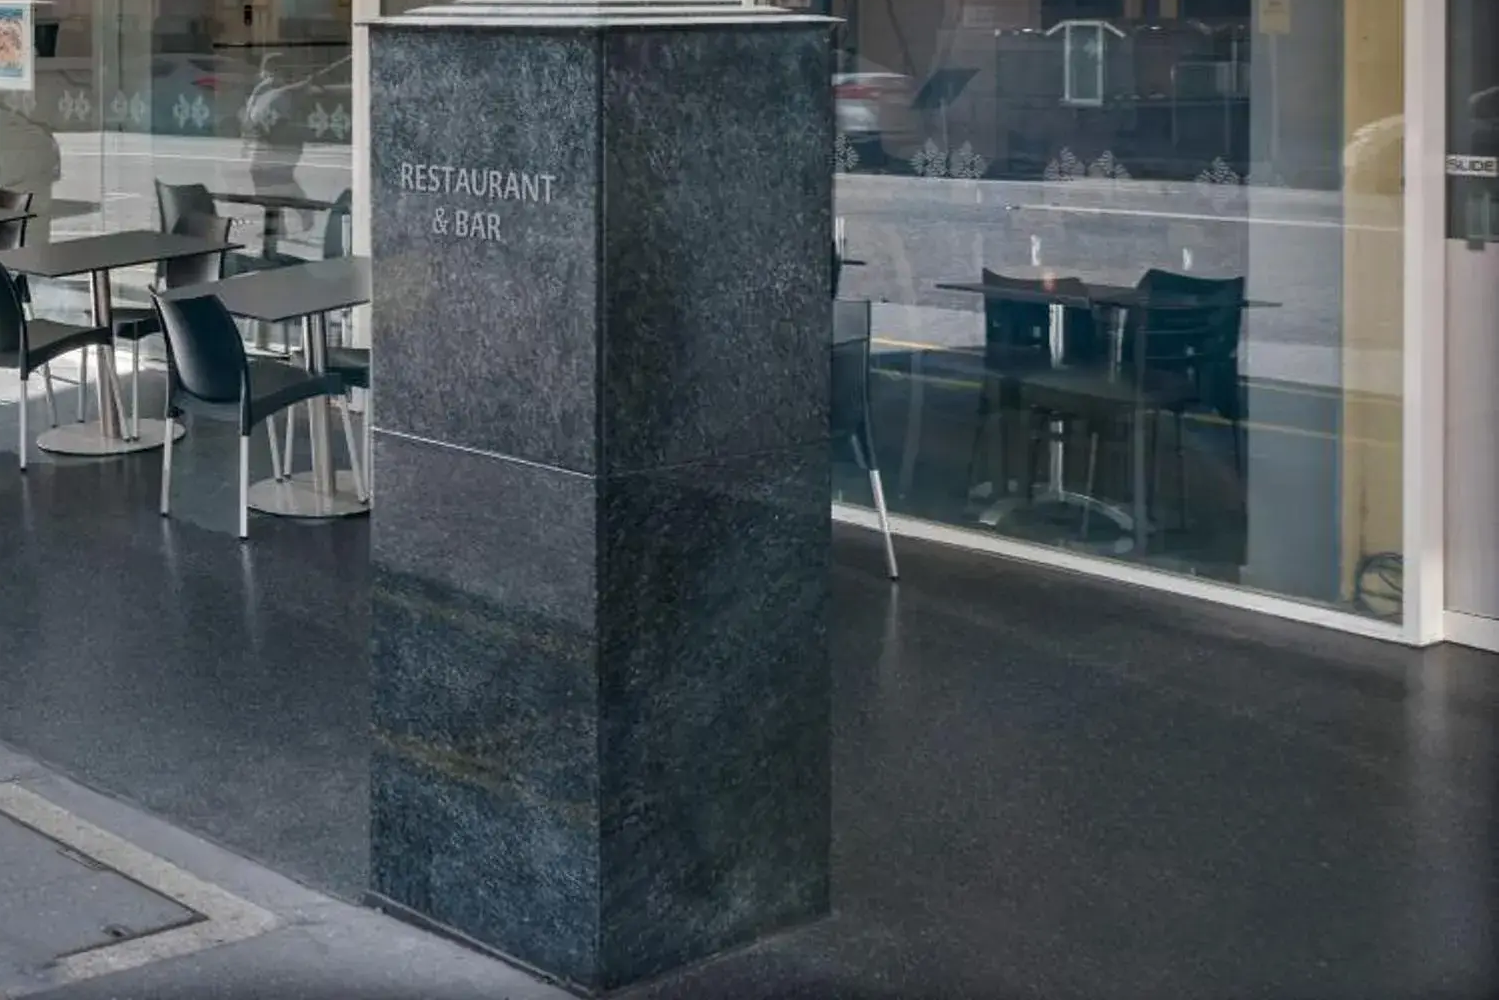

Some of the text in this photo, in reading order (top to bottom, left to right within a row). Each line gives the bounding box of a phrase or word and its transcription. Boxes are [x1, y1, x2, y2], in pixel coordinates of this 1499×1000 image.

[401, 162, 556, 204] RESTAURANT
[432, 206, 501, 241] & BAR
